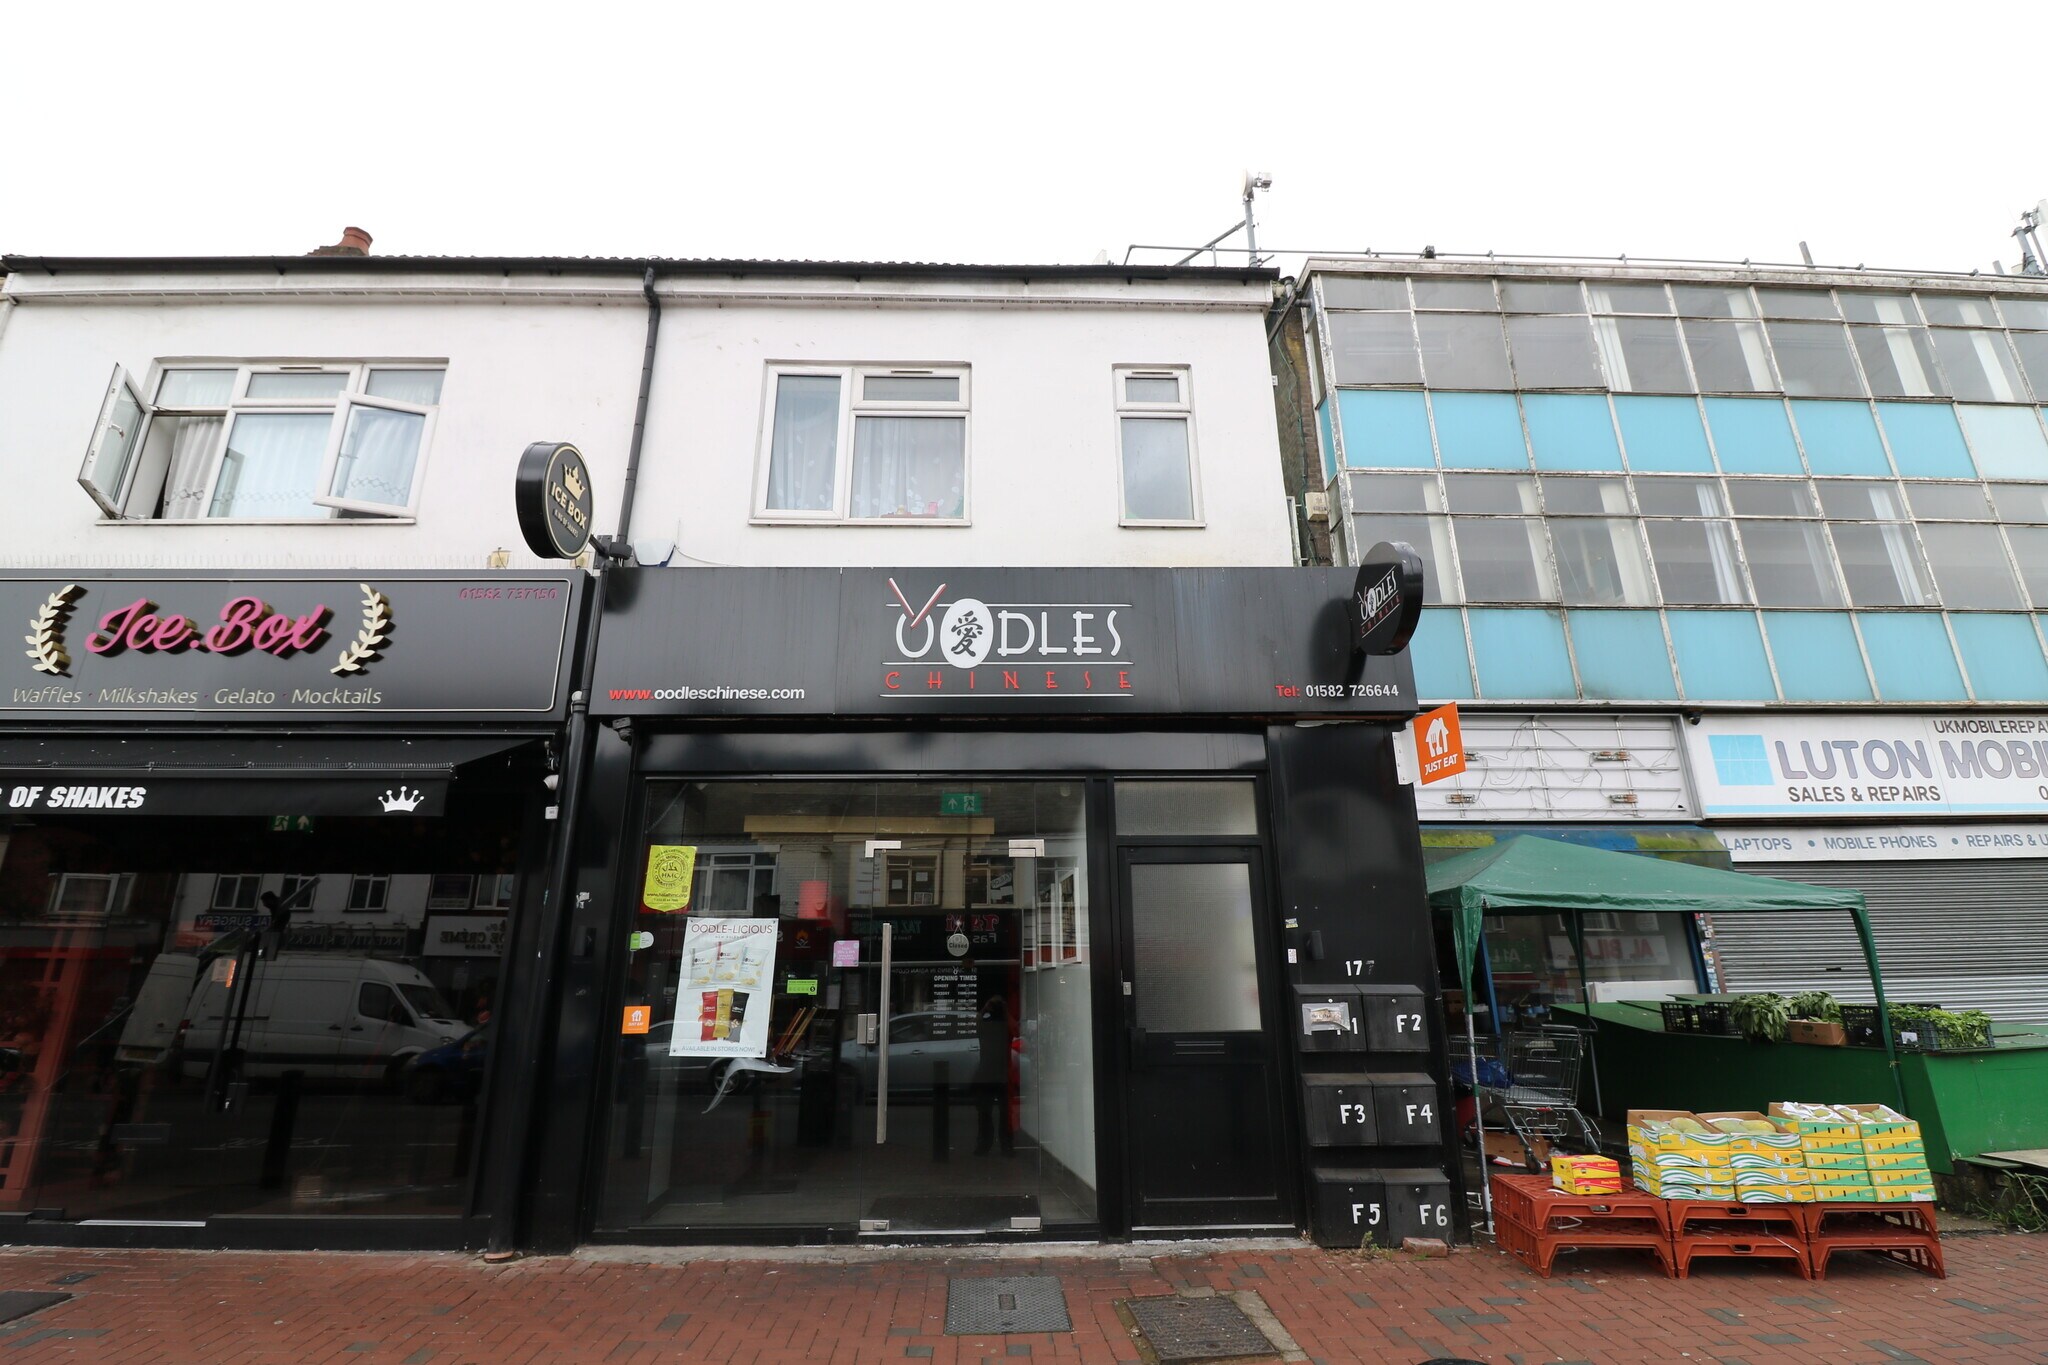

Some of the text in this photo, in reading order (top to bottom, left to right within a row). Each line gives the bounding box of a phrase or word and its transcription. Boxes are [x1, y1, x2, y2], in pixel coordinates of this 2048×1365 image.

[550, 481, 587, 530] ICE BOX
[460, 587, 558, 600] 01582 737150
[950, 610, 984, 658] 愛
[885, 671, 1132, 689] CHINESE
[13, 686, 383, 704] Waffles Milkshakes Gelato Mocktails
[609, 686, 805, 701] www.oodleschinese.com
[1275, 684, 1399, 697] Tel: 01582 726644
[1933, 720, 2048, 734] UKMOBILEREPA
[1424, 753, 1458, 776] JUST EAT
[1775, 739, 1933, 780] LUTON
[8, 786, 44, 808] OF
[46, 786, 147, 809] SHAKES
[1788, 785, 1942, 802] SALES & REPAIRS
[1723, 837, 1792, 852] LAPTOPS
[1824, 836, 1877, 850] MOBILE
[1880, 835, 1937, 849] PHONES
[1966, 834, 2024, 847] REPAIRS
[2026, 834, 2037, 846] &
[691, 923, 773, 934] OODLE-LICIOUS
[1396, 1014, 1422, 1033] F2
[1340, 1104, 1366, 1124] F3
[1406, 1103, 1433, 1125] F4
[1352, 1203, 1381, 1225] F5
[1419, 1204, 1448, 1226] F6
